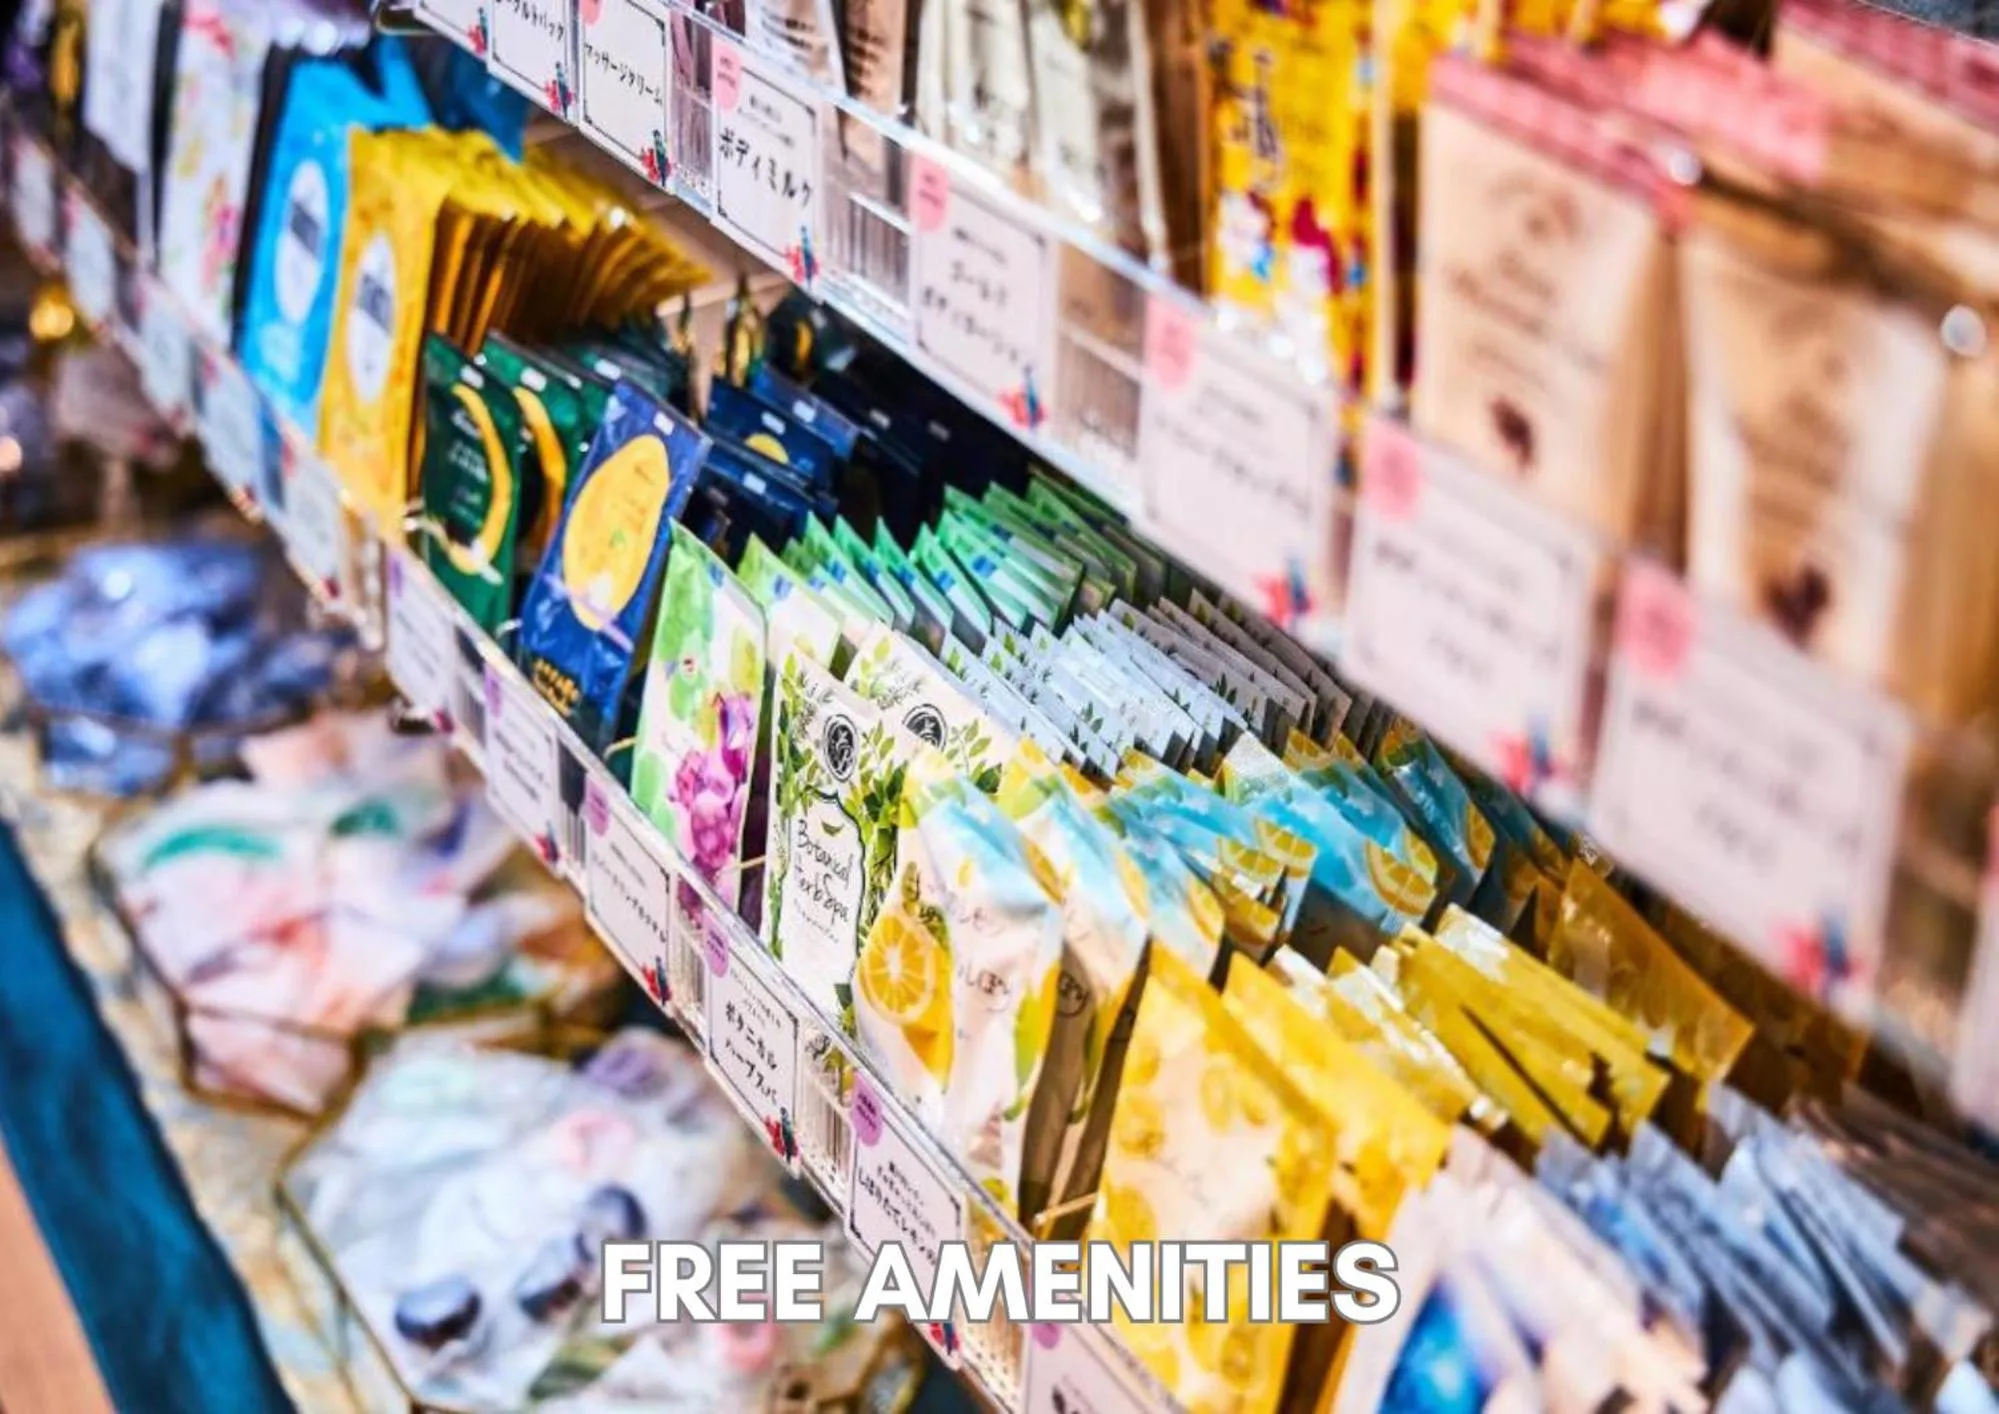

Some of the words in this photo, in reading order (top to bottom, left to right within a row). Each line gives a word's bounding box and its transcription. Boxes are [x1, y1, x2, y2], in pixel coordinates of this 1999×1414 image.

[719, 127, 812, 209] ボディミルク
